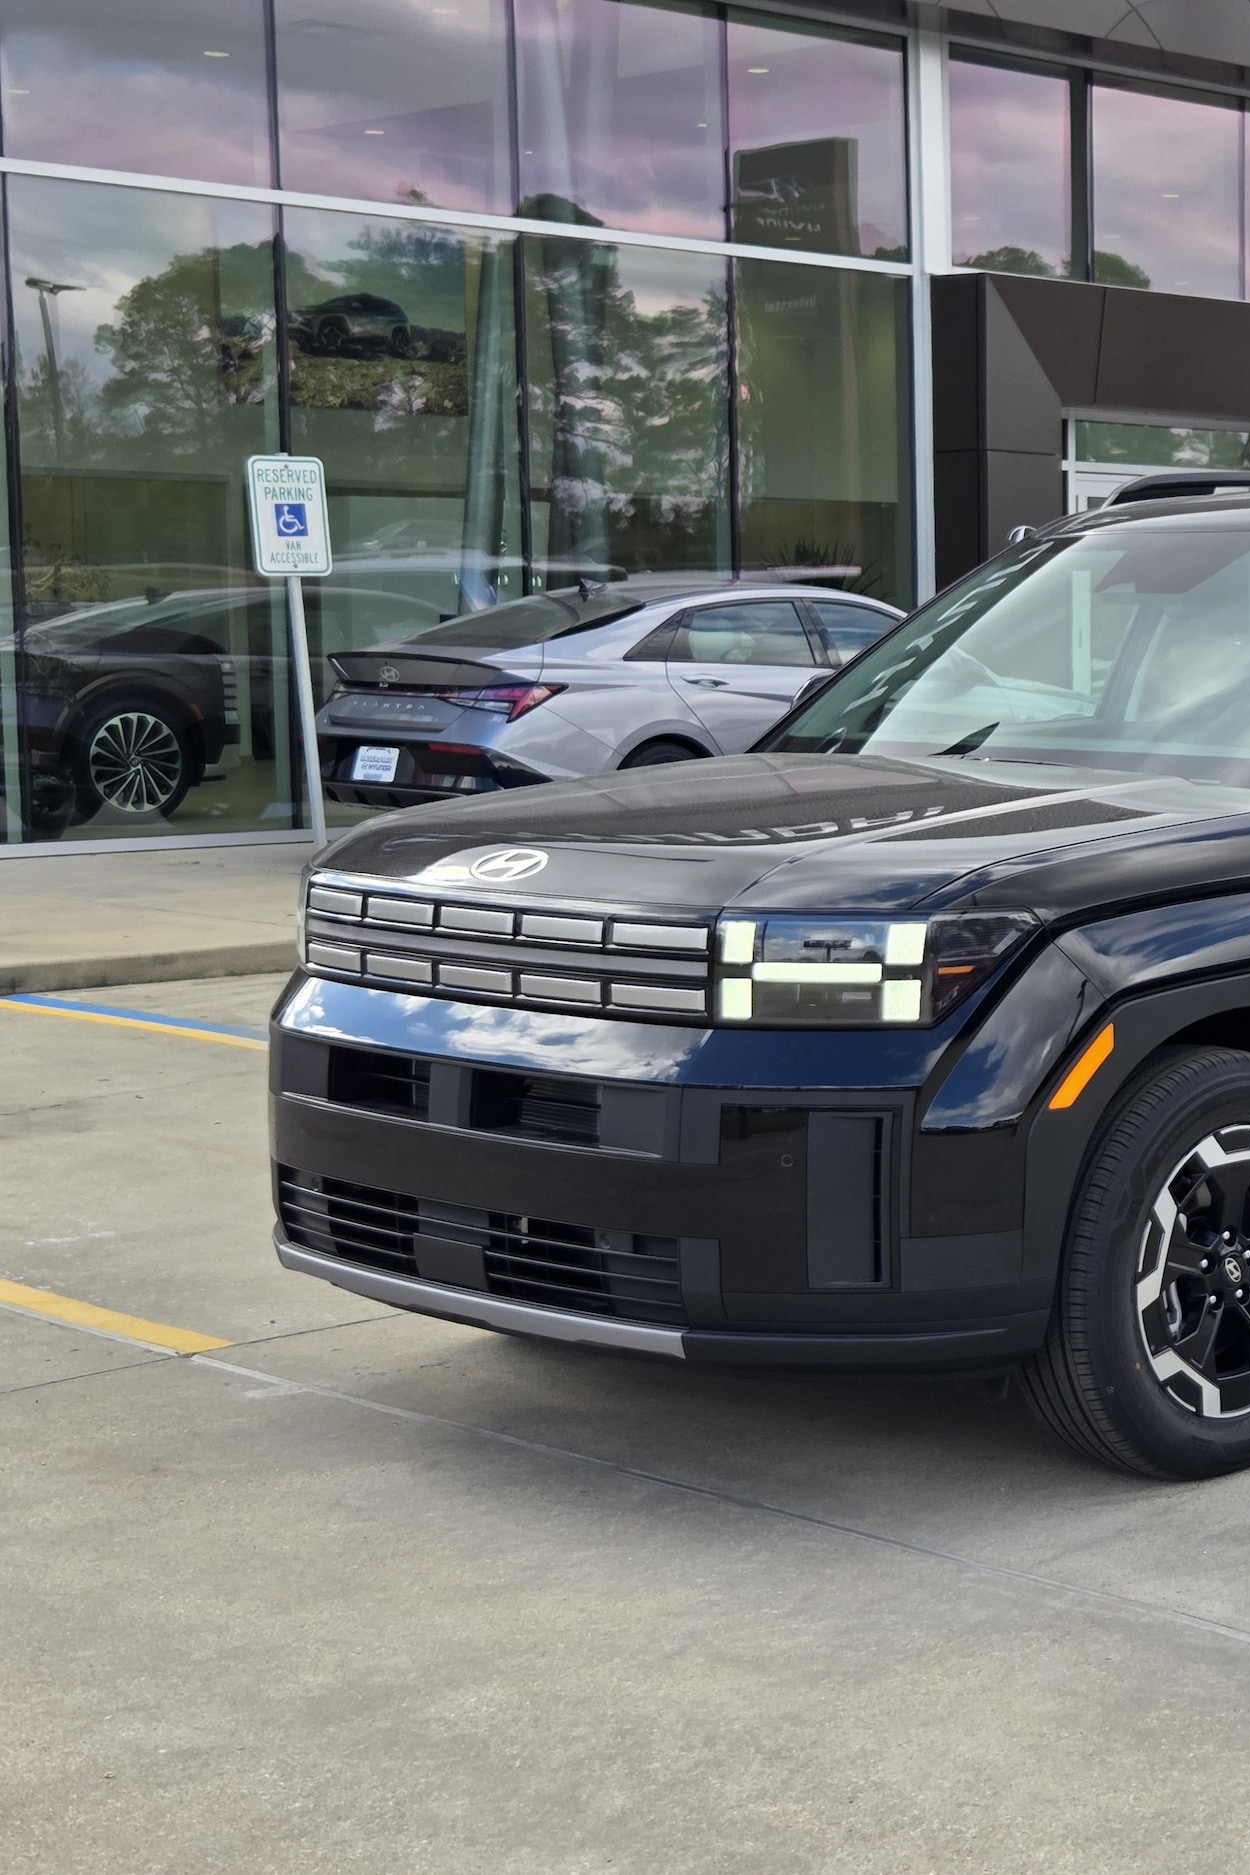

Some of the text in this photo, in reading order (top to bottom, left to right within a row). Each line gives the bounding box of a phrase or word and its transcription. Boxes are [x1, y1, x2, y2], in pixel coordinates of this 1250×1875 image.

[256, 468, 317, 484] RESERVED
[264, 486, 313, 501] PARKING
[284, 540, 302, 551] VAN
[270, 552, 319, 564] ACCESSIBLE
